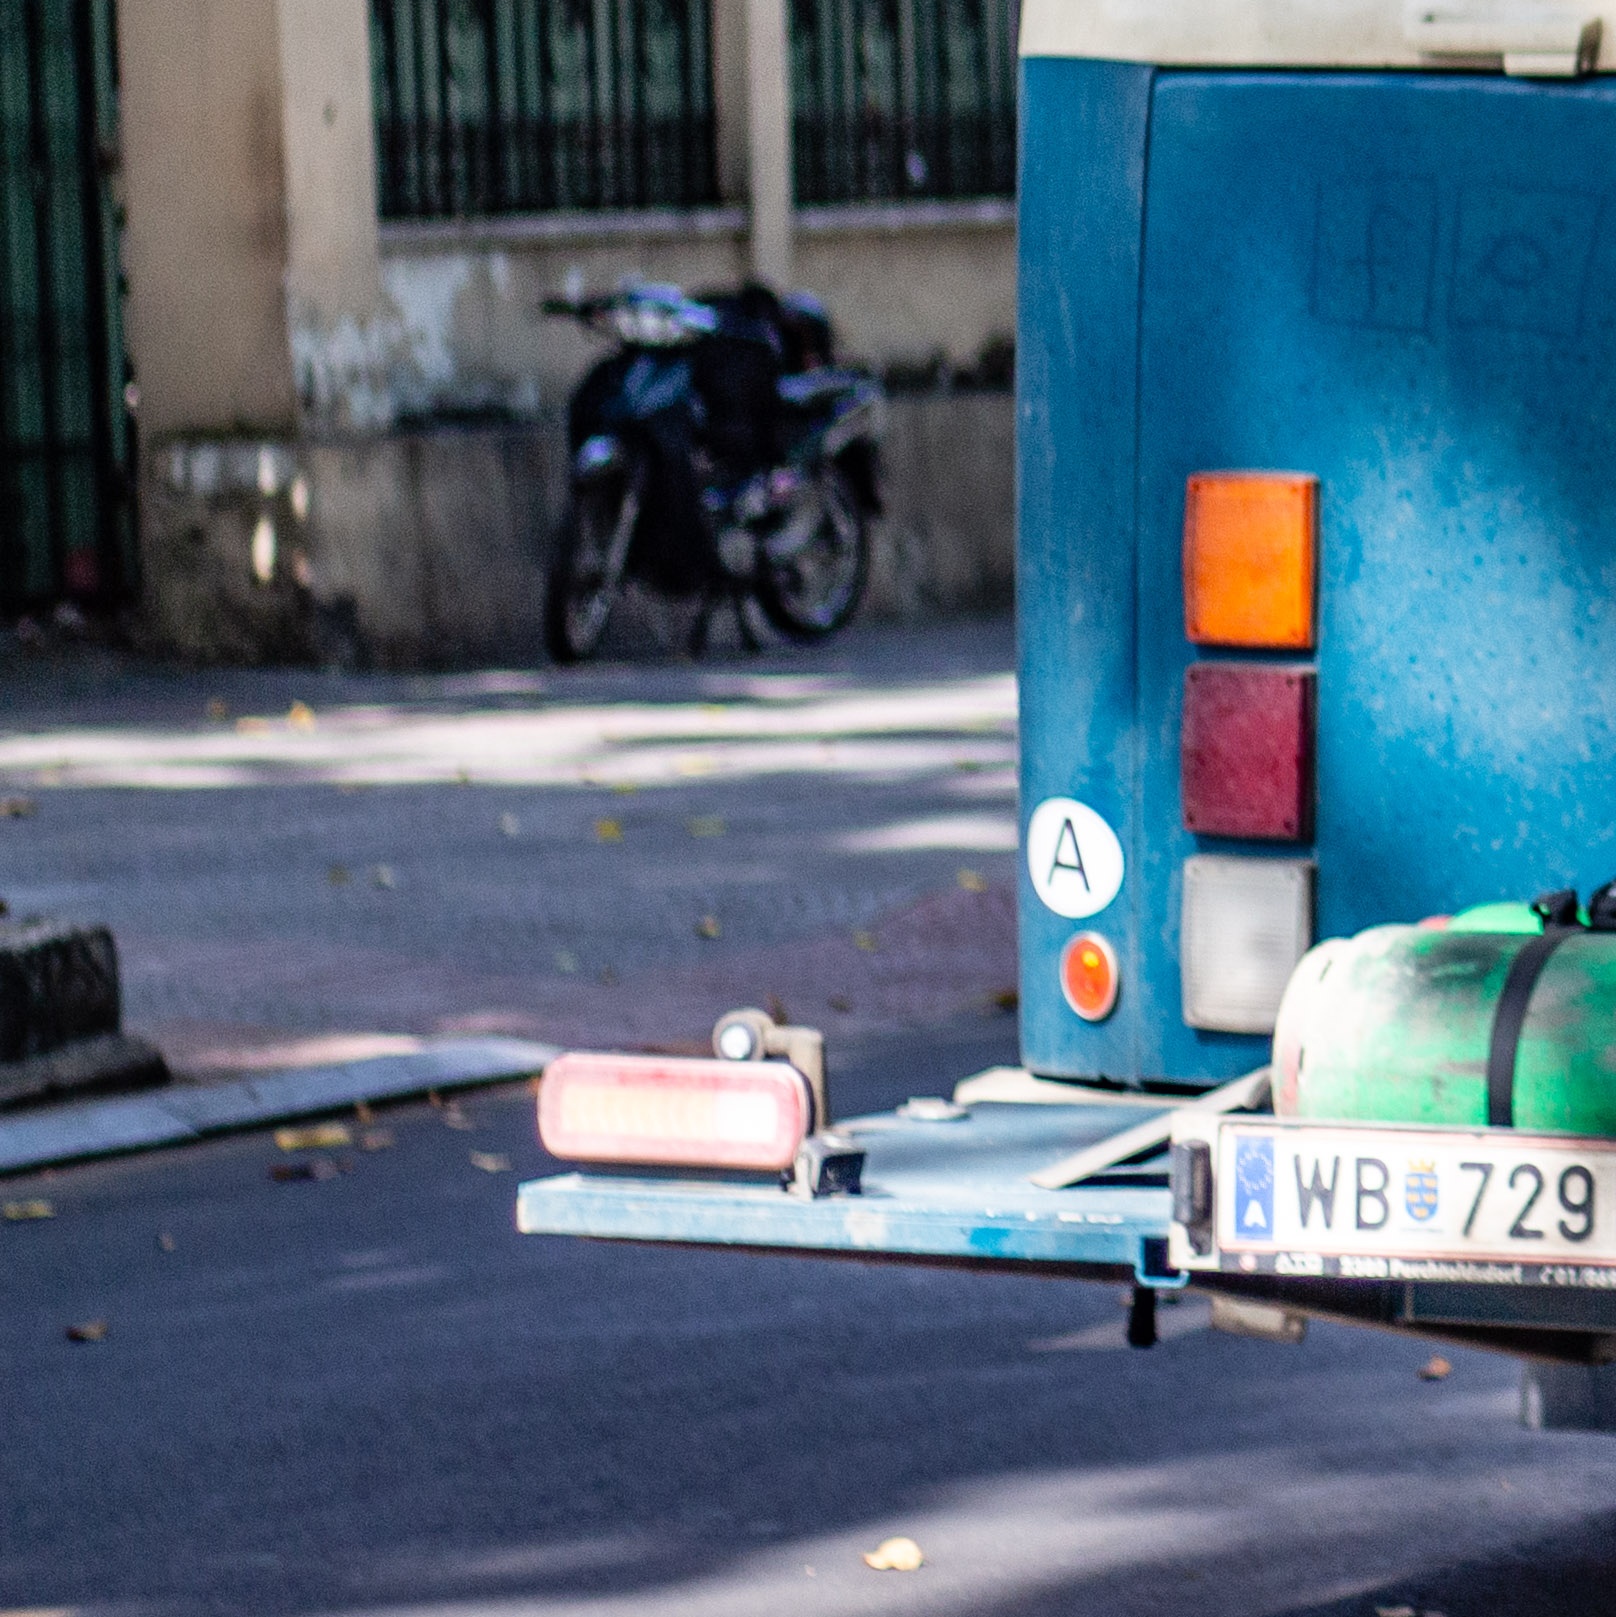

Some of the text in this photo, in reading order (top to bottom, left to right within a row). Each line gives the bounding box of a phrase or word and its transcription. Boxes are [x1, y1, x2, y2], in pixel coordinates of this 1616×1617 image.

[1047, 816, 1091, 893] A
[1243, 1198, 1268, 1229] A
[1293, 1152, 1390, 1231] WB
